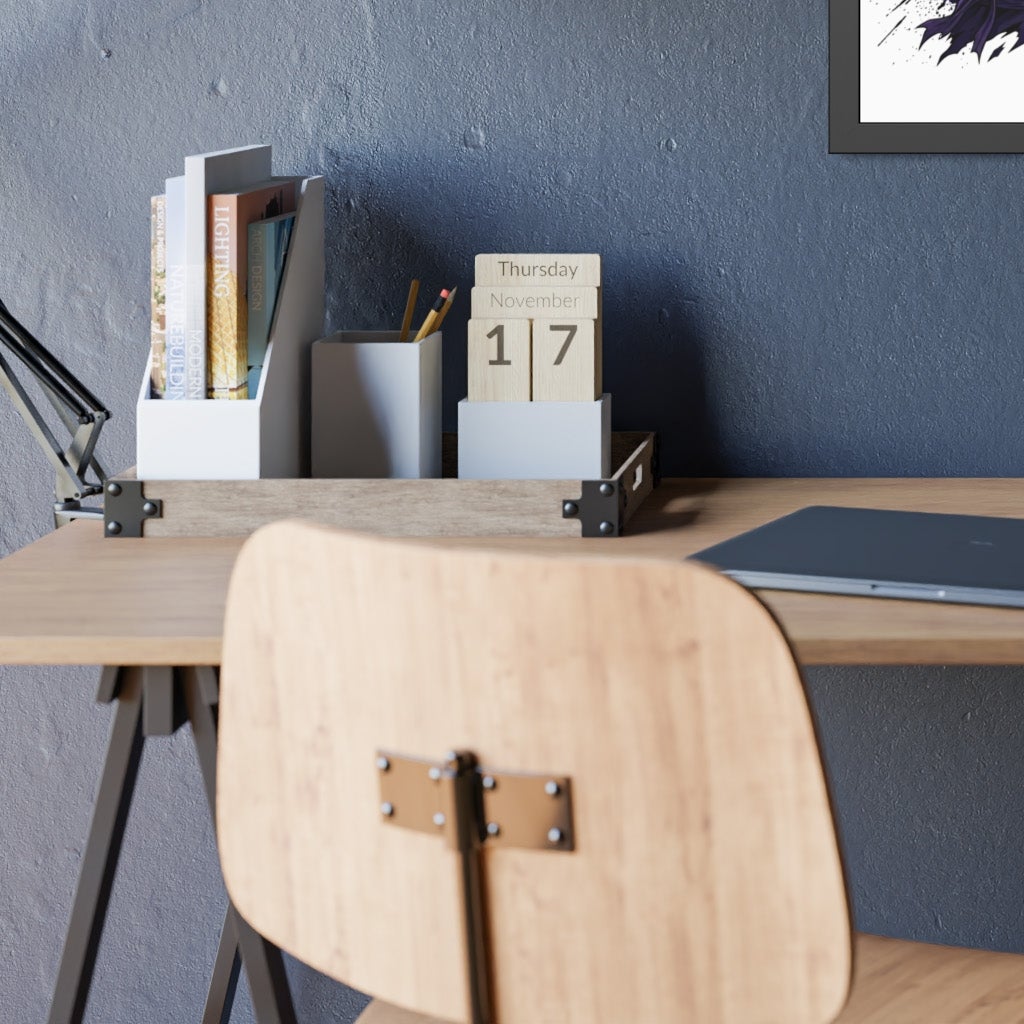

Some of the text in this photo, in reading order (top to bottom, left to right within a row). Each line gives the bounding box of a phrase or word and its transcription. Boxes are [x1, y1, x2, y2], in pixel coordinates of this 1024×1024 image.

[156, 200, 165, 229] DESIGN
[213, 205, 230, 298] LIGHTING
[497, 260, 579, 280] Thursday
[252, 264, 263, 311] DESIGN
[489, 292, 581, 309] November
[189, 328, 203, 399] MODERN
